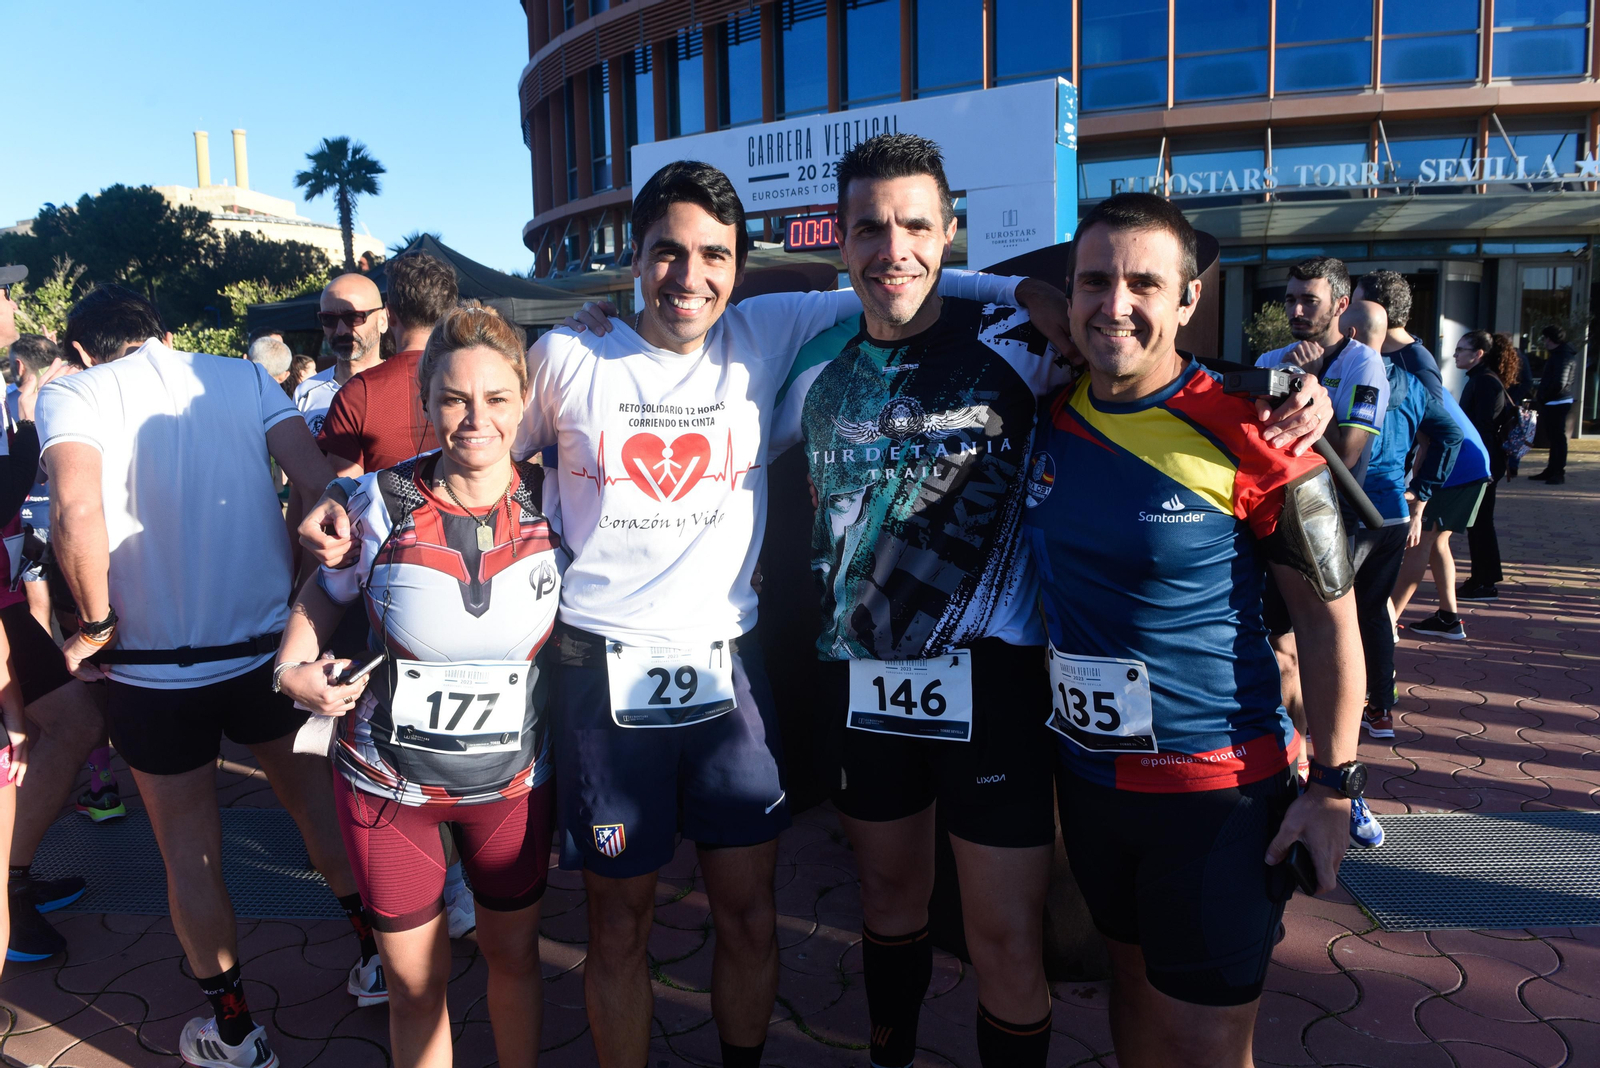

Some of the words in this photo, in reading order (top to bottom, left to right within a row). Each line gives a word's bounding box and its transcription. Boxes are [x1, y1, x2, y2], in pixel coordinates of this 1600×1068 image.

[748, 127, 812, 167] CARRERA
[1418, 154, 1560, 184] SEVILLA
[752, 186, 810, 201] EUROSTARS
[810, 184, 837, 195] TOR
[790, 219, 839, 247] 00:0
[985, 228, 1036, 240] EUROSTARS
[619, 403, 641, 413] RETO
[641, 403, 683, 415] SOLIDARIO
[685, 407, 696, 416] 12
[697, 401, 726, 415] HORAS
[628, 418, 677, 428] CORRIENDO
[679, 418, 690, 428] EN
[691, 417, 716, 427] CINTA
[812, 437, 1012, 464] TURDETANIA
[868, 465, 942, 480] TRAIL
[599, 513, 671, 530] Corazón
[677, 519, 686, 538] y
[1138, 511, 1206, 524] Santander
[647, 665, 698, 705] 29
[872, 675, 947, 717] 146
[426, 691, 500, 731] 177
[1058, 682, 1122, 732] 135
